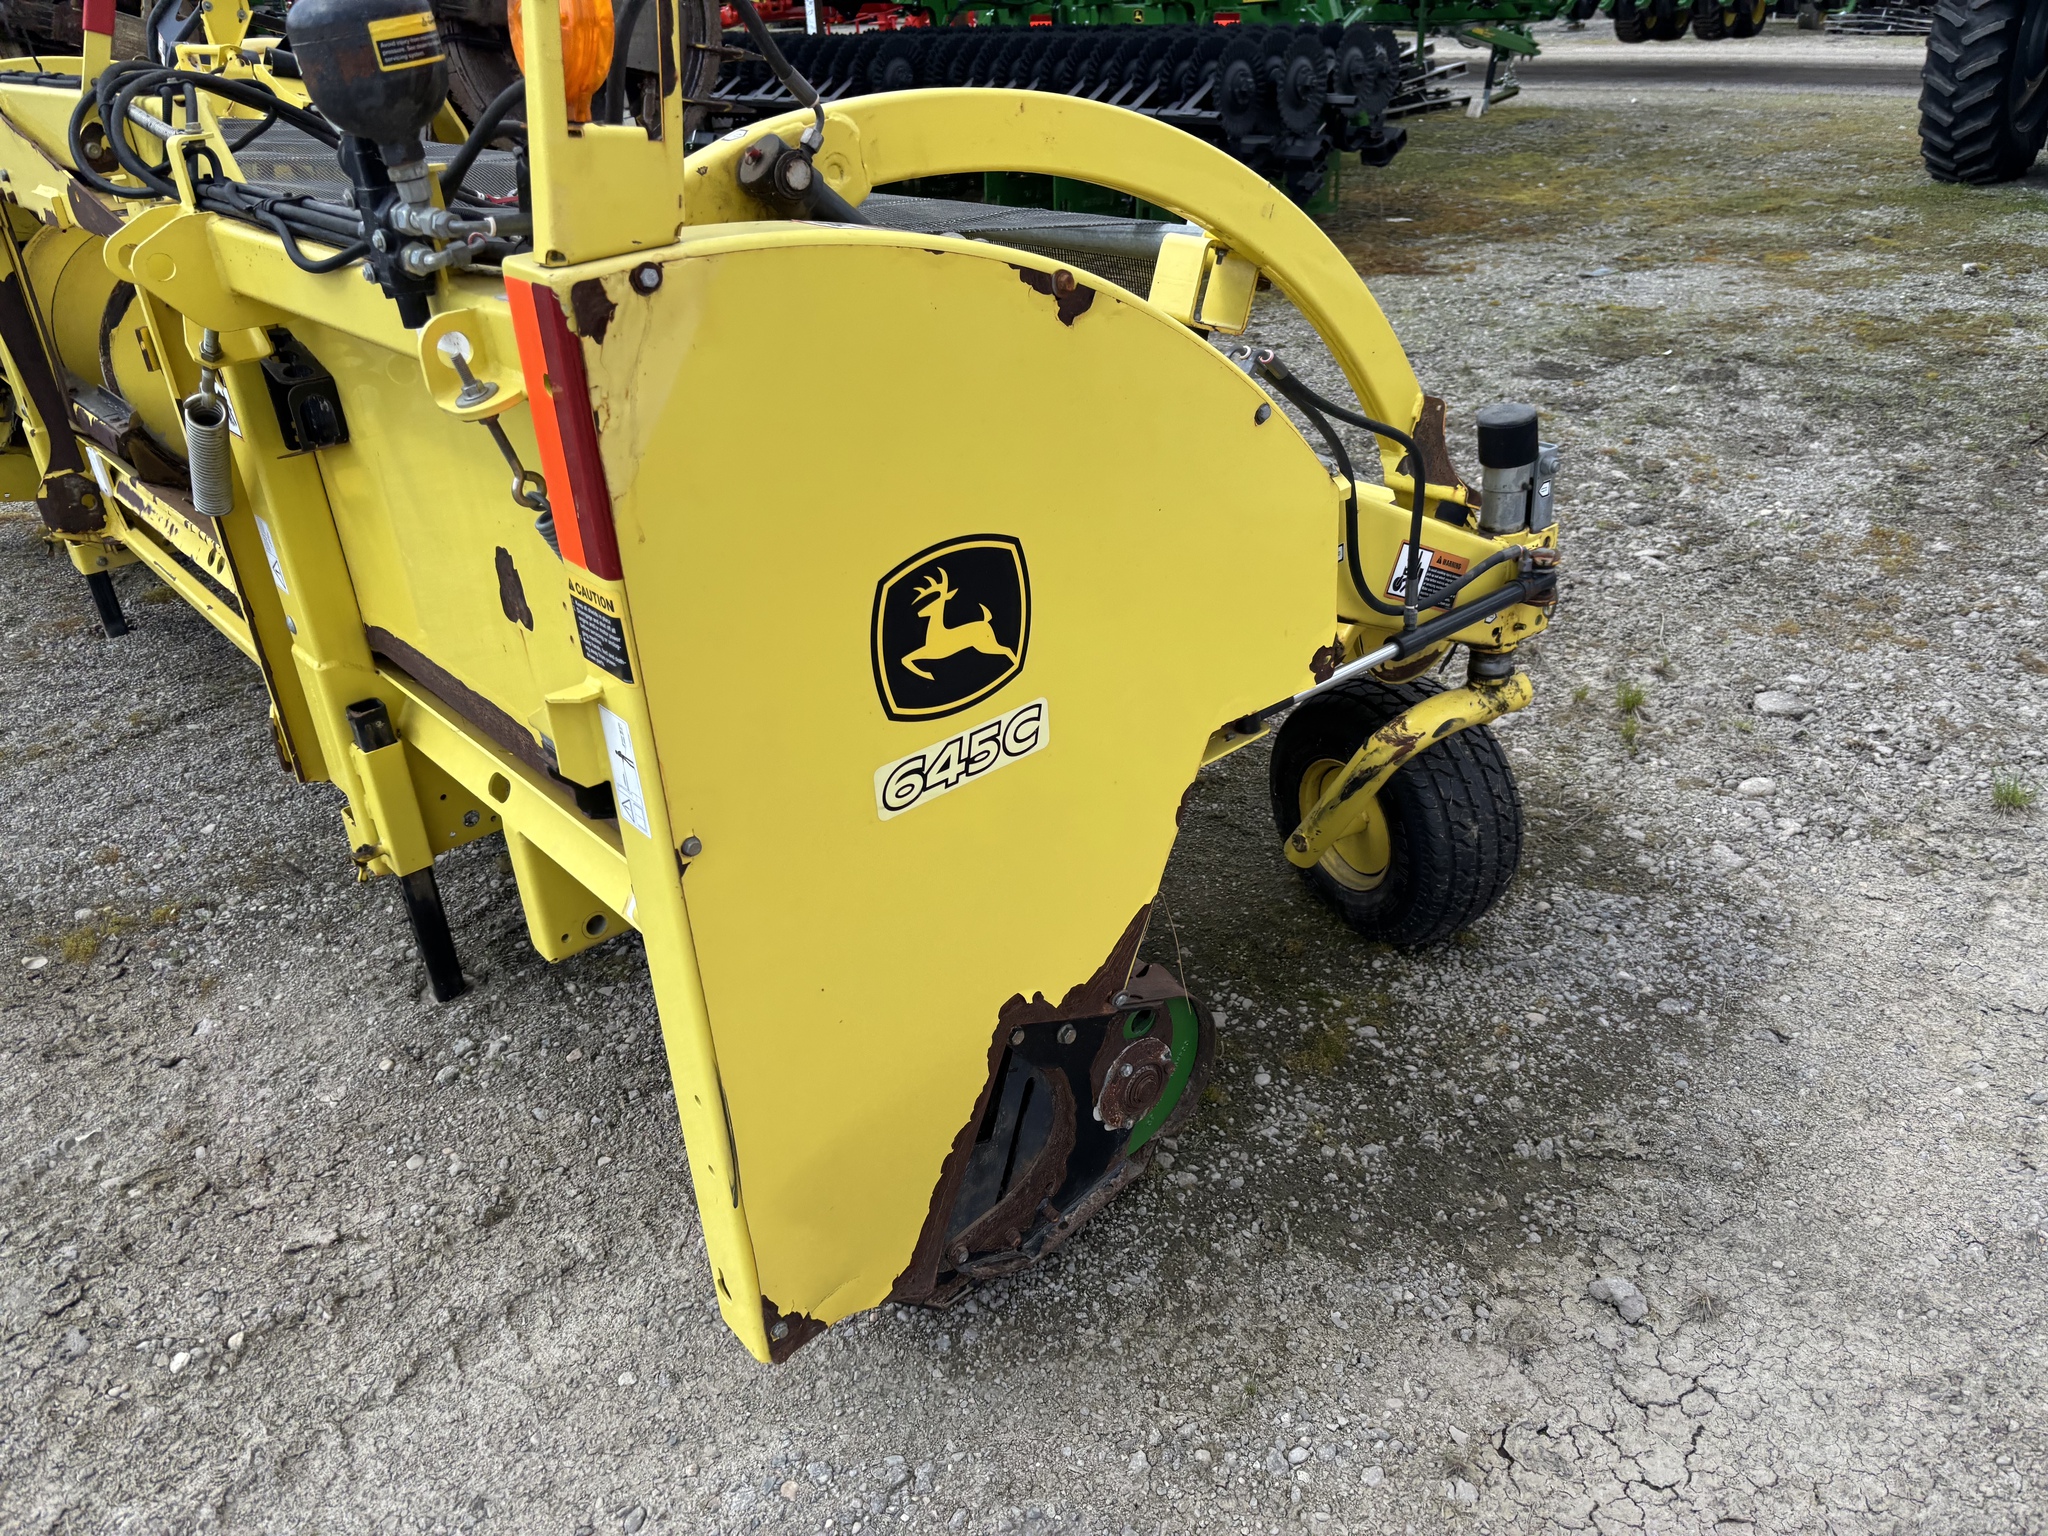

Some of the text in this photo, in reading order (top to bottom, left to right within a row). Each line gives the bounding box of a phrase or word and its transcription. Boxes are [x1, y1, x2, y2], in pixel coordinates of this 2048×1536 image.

[1443, 559, 1462, 569] WARNING
[575, 582, 614, 612] CAUTION
[882, 703, 1043, 812] 645C
